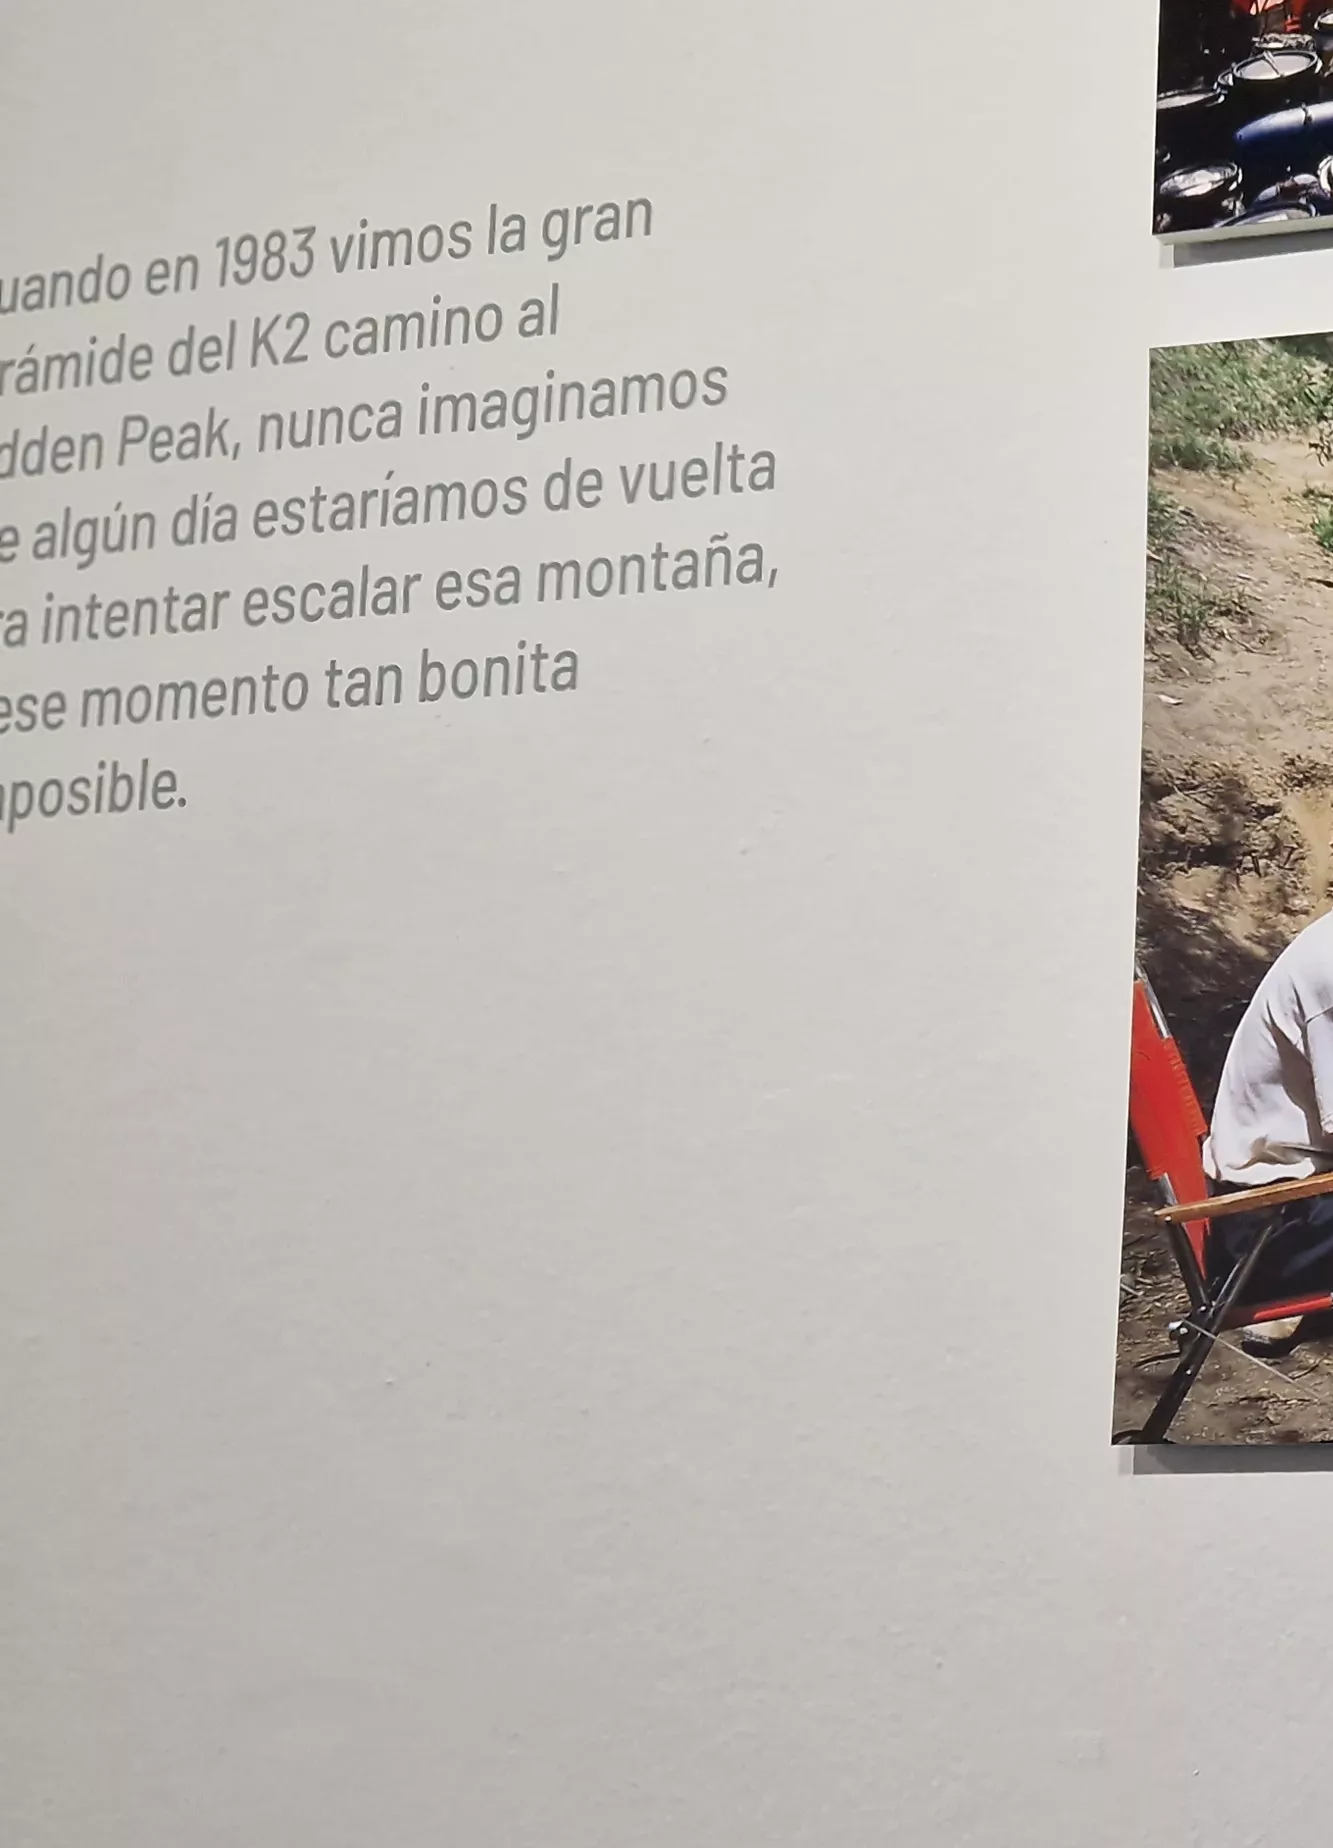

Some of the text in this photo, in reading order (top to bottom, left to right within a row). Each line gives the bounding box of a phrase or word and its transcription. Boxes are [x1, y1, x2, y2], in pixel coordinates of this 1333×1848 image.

[145, 254, 199, 297] en
[215, 225, 317, 288] 1983
[329, 217, 473, 274] vimos
[487, 203, 526, 255] la
[541, 197, 653, 263] gran
[167, 319, 237, 378] del
[250, 311, 311, 369] K2
[324, 293, 503, 359] camino
[518, 282, 560, 338] al
[117, 406, 241, 467] Peak,
[258, 399, 403, 453] nunca
[418, 365, 728, 441] imaginamos
[31, 501, 156, 571] algún
[171, 491, 238, 547] día
[252, 469, 528, 539] estaríamos
[543, 456, 604, 512] de
[619, 440, 776, 505] vuelta
[41, 585, 231, 645] intentar
[243, 563, 423, 628] escalar
[435, 565, 521, 611] esa
[537, 531, 778, 603] montaña,
[80, 664, 309, 728] momento
[324, 659, 403, 709] tan
[418, 639, 579, 703] bonita
[0, 757, 187, 835] posible.
